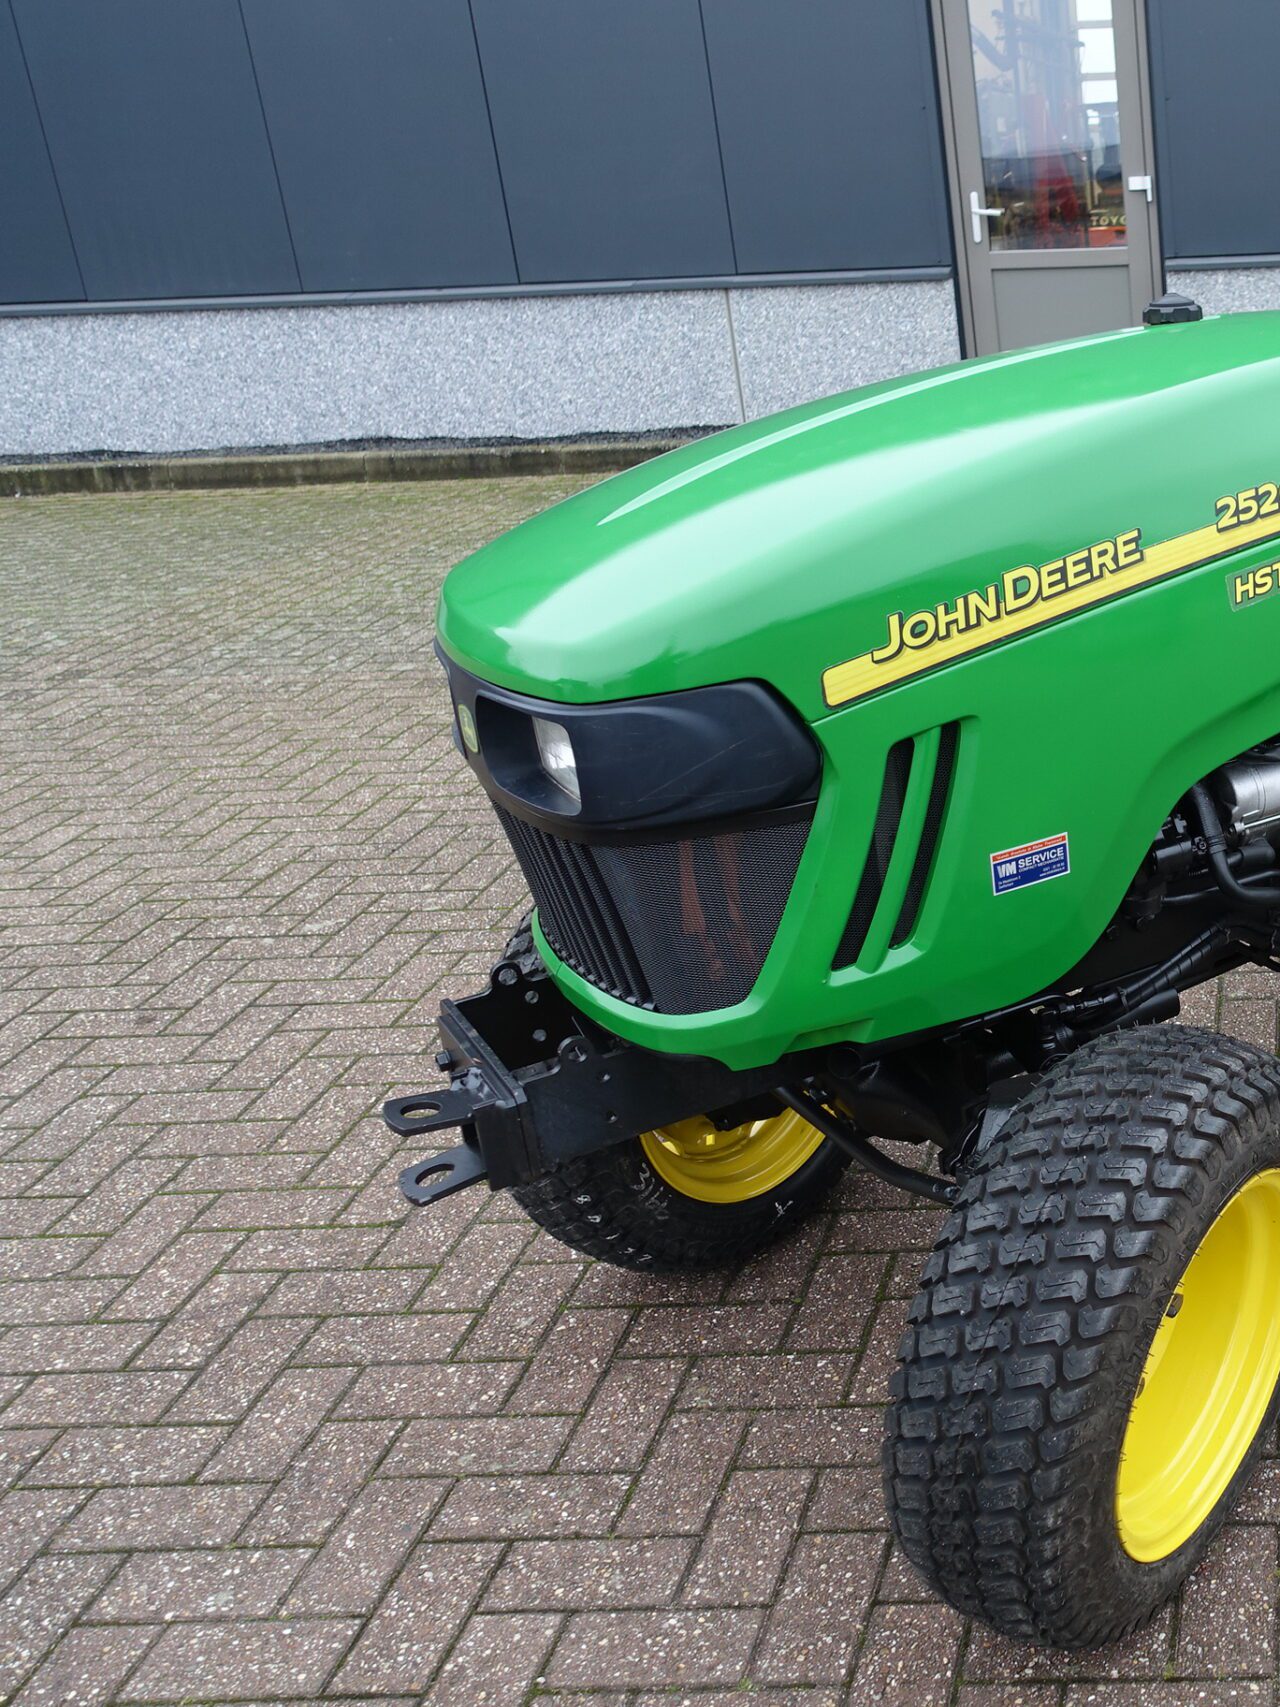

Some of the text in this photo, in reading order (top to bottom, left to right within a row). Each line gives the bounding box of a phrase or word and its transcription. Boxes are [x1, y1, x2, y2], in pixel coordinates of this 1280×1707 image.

[871, 528, 1144, 664] JOHN DEERE
[997, 861, 1017, 878] VM
[1018, 847, 1064, 868] SERVICE
